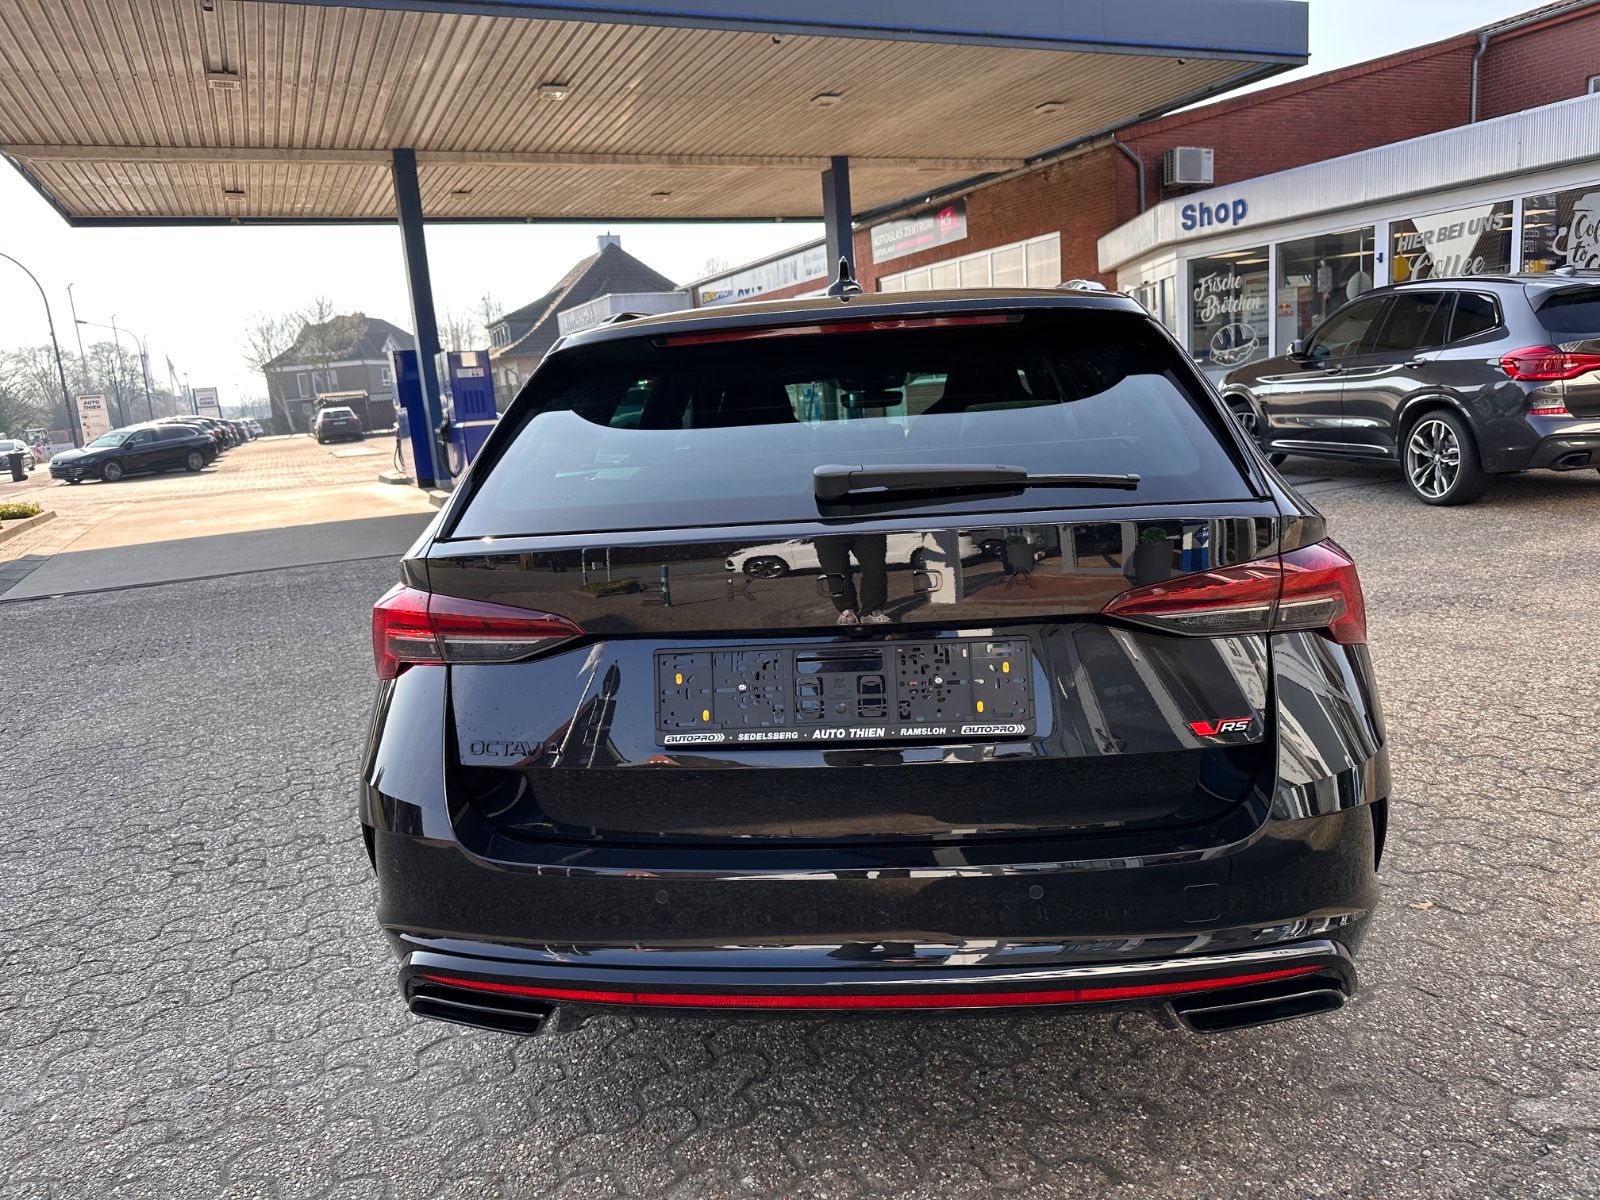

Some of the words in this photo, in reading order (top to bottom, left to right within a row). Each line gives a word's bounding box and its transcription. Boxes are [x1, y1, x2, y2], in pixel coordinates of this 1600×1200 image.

[1181, 199, 1248, 231] Shop
[1397, 230, 1433, 252] HIER
[1436, 222, 1464, 243] BEI
[1467, 212, 1504, 235] UNS
[1193, 271, 1243, 301] Frische
[1200, 295, 1262, 322] Brötchen
[737, 731, 799, 741] SEDELSBERG
[812, 728, 846, 739] AUTO
[849, 727, 886, 738] THIEN
[900, 727, 947, 736] RAMSLOH
[470, 740, 564, 757] OCTAVIA
